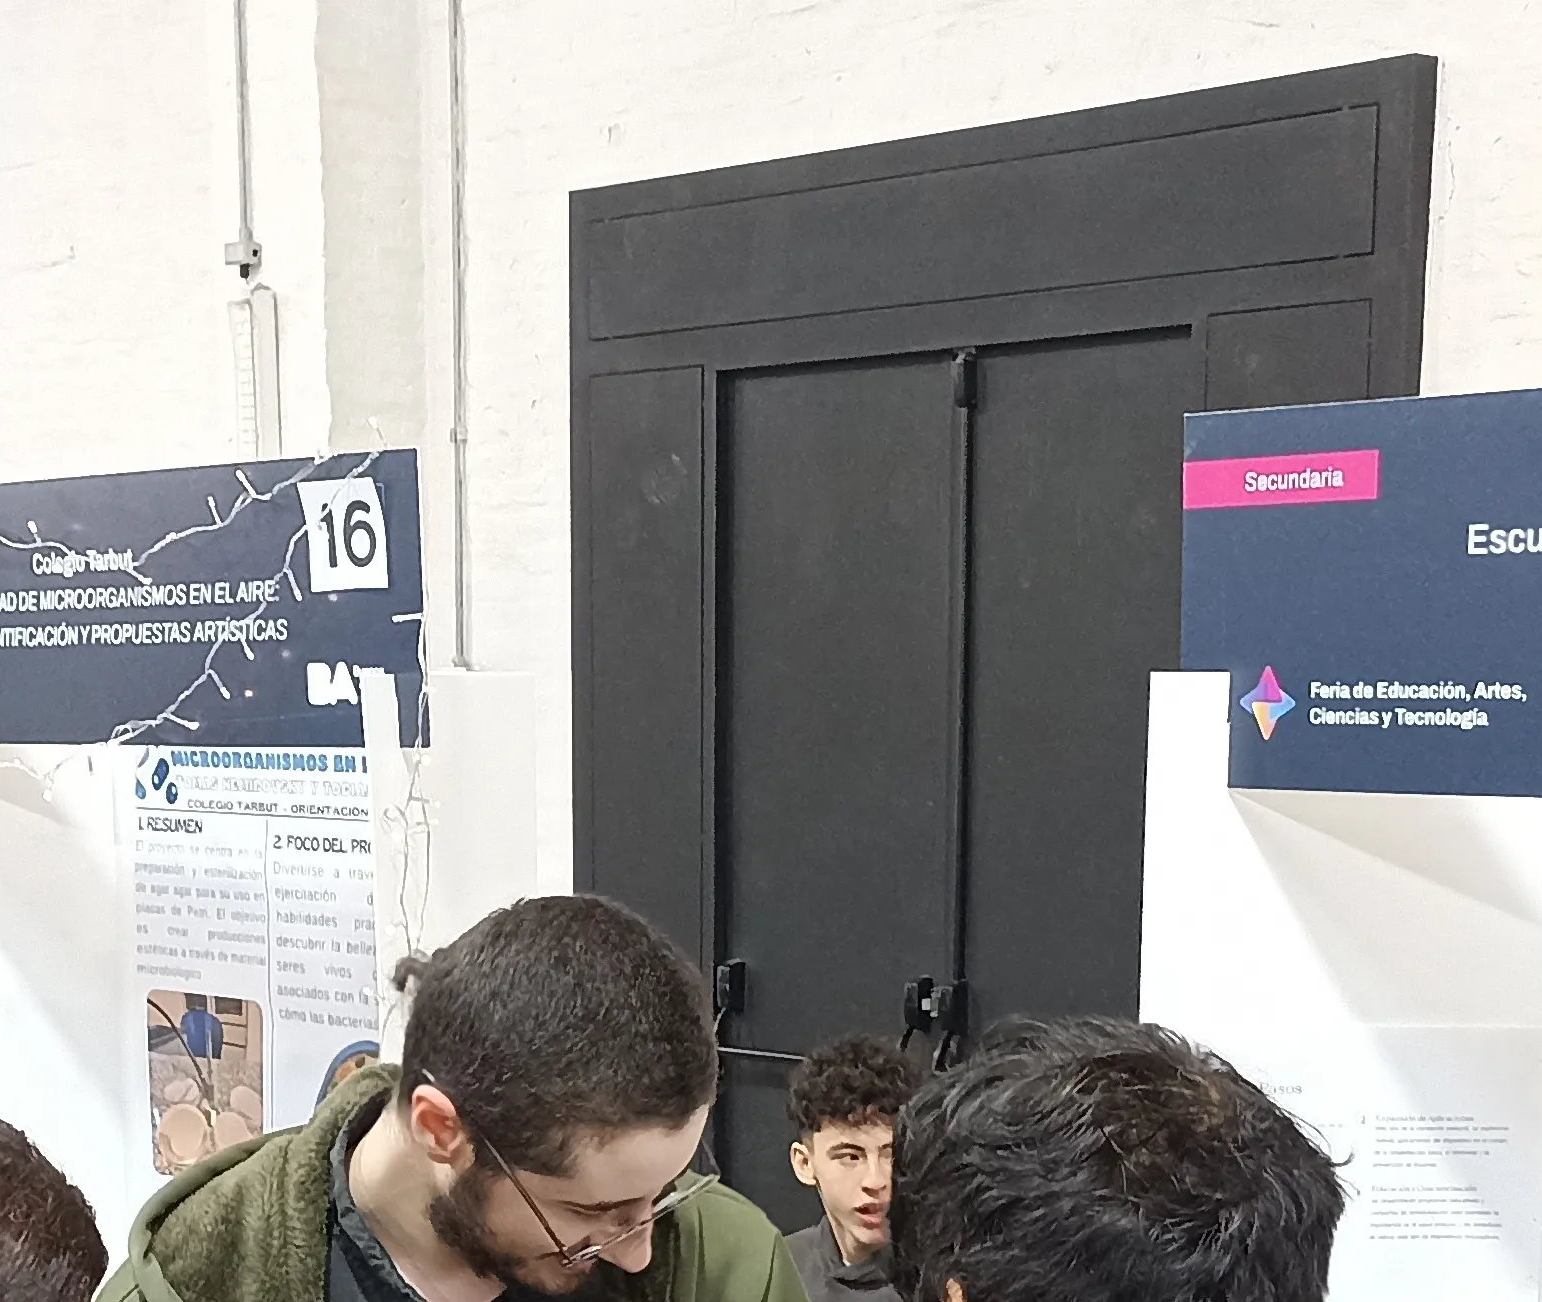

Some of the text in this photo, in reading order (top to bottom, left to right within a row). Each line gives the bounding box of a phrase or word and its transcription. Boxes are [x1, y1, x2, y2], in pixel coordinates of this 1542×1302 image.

[1244, 466, 1344, 492] Secundaria
[320, 500, 376, 568] 16
[86, 549, 134, 572] Tarbut
[18, 590, 38, 612] DE
[39, 584, 190, 610] MICROORGANISMOS
[190, 583, 213, 604] EN
[215, 582, 234, 603] EL
[79, 625, 91, 644] Y
[91, 620, 191, 645] PROPUESTAS
[193, 616, 288, 641] ARTÍSTICAS
[306, 661, 359, 705] BA
[1310, 680, 1527, 703] Feria de Educación, Artes,
[1309, 706, 1489, 730] Ciencias y Tecnología
[171, 750, 329, 772] MICROORGANISMOS
[333, 755, 356, 773] EN
[187, 799, 234, 810] COLEGIO
[238, 801, 279, 812] TARBUT
[146, 817, 203, 834] RESUMEN
[287, 835, 320, 851] FOCO
[322, 837, 347, 853] DEL
[333, 868, 340, 879] a
[276, 910, 338, 928] habilidades
[276, 935, 326, 951] descubrir
[331, 938, 340, 953] la
[276, 960, 352, 979] seres vivos
[276, 984, 330, 1001] asociados
[334, 990, 355, 1003] con
